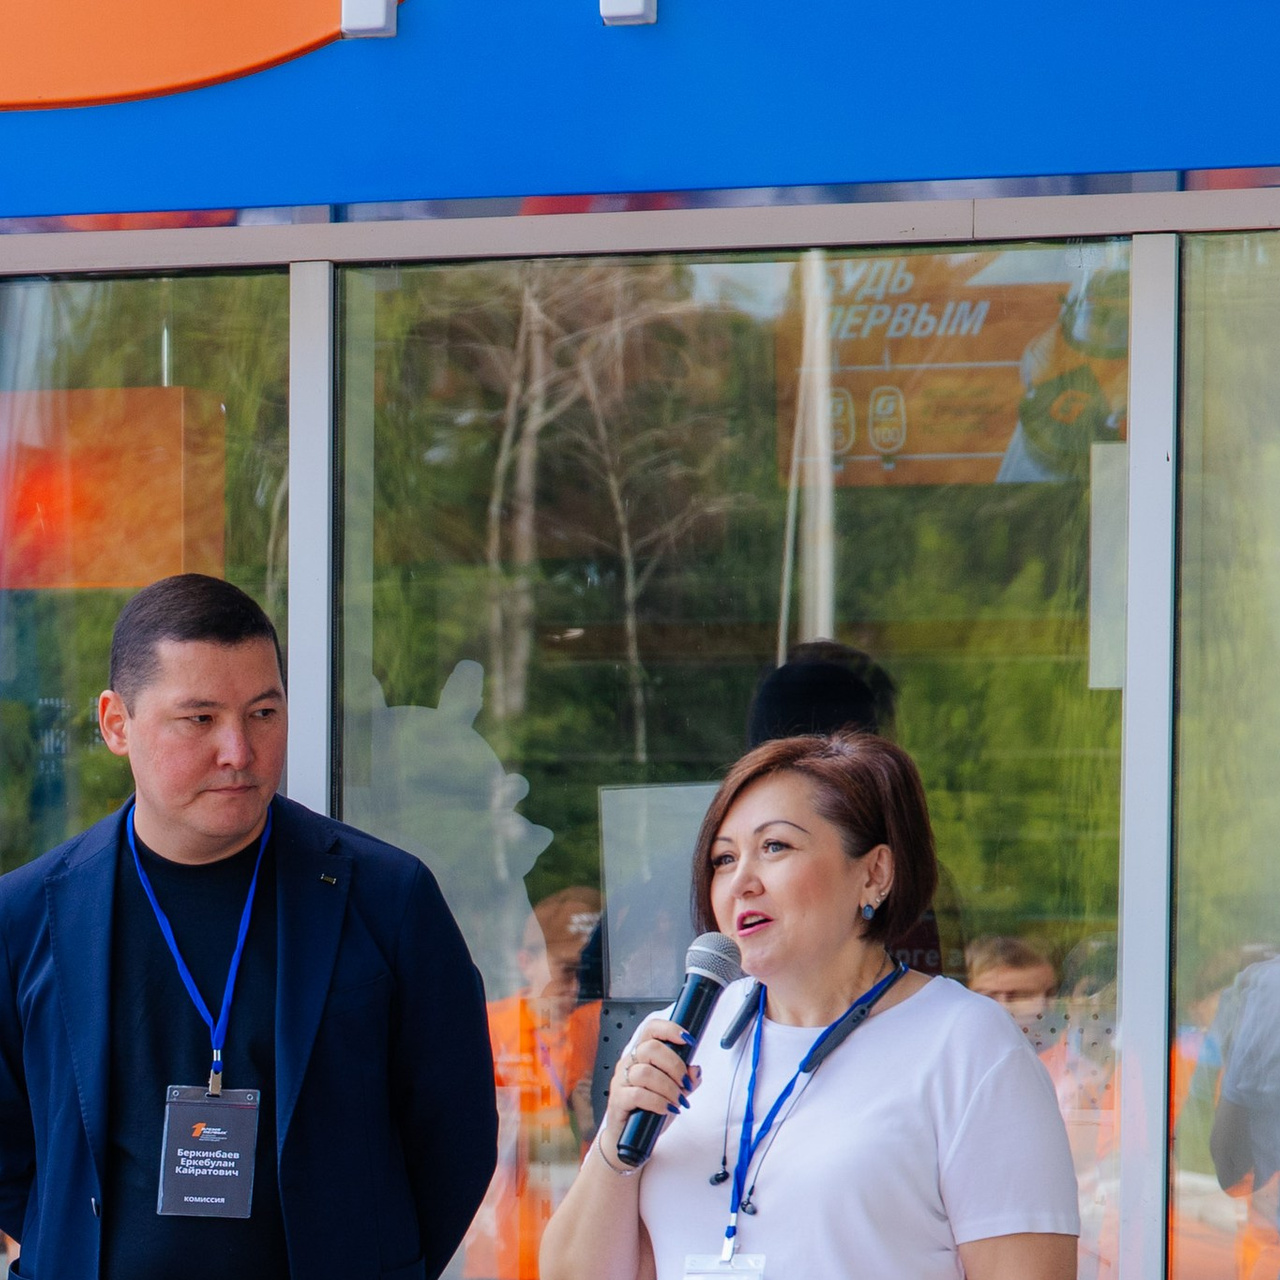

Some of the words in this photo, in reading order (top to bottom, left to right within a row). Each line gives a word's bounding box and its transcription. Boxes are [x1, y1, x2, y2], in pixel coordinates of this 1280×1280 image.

[177, 1148, 240, 1159] Беркинбаев
[180, 1157, 235, 1168] Еркебулан
[175, 1166, 239, 1176] Кайратович
[183, 1196, 226, 1204] КОМИССИЯ
